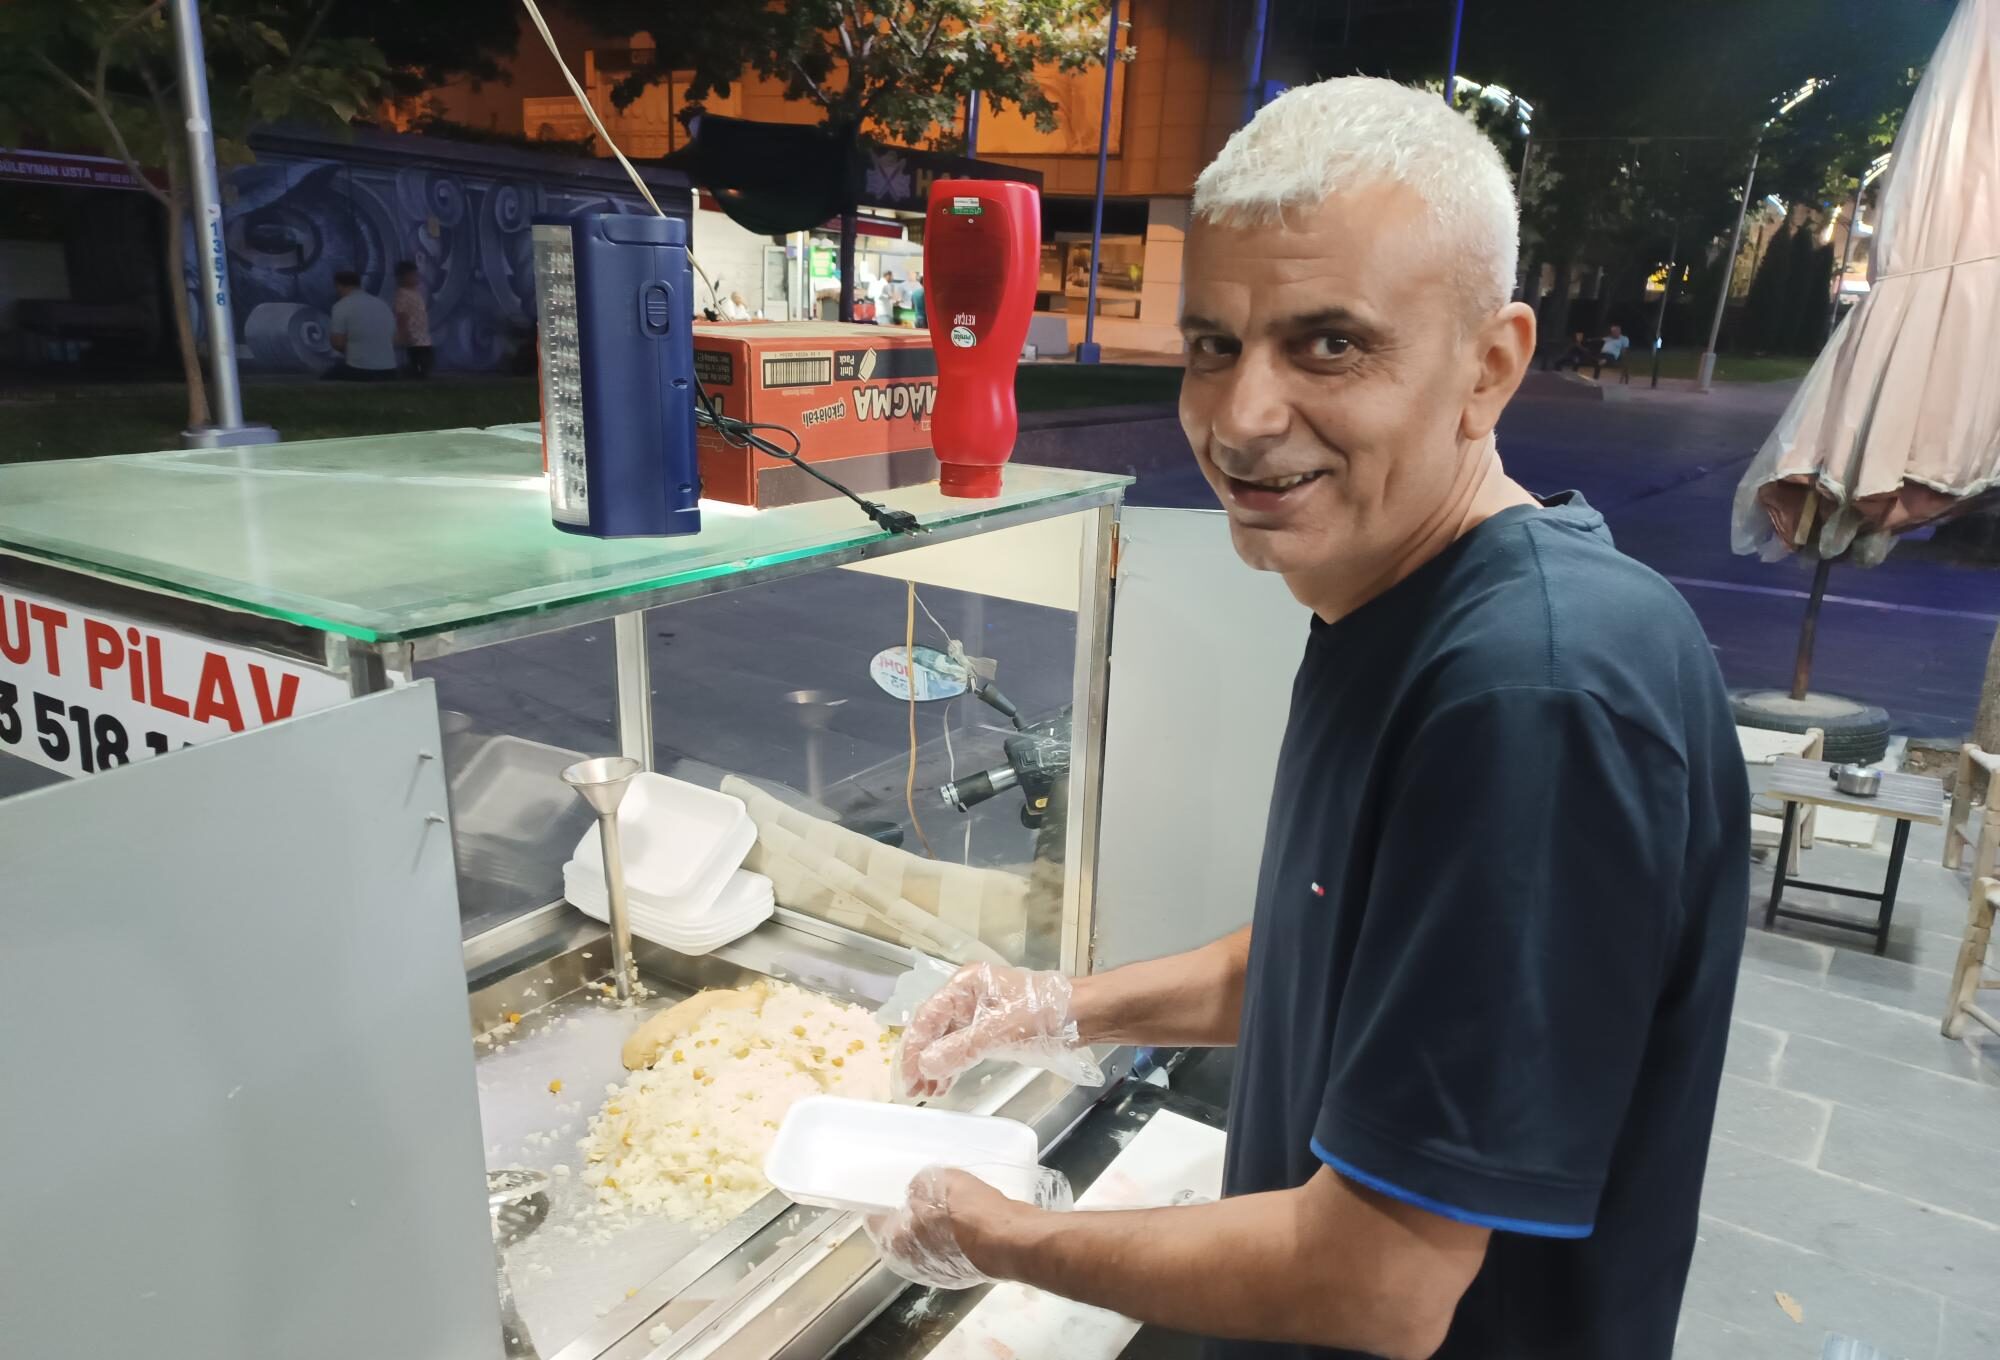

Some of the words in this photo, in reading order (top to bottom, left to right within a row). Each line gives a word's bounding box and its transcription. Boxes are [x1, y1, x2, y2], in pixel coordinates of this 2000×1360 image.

[839, 355, 855, 365] Pack
[839, 366, 854, 377] Unit
[33, 691, 129, 773] 518
